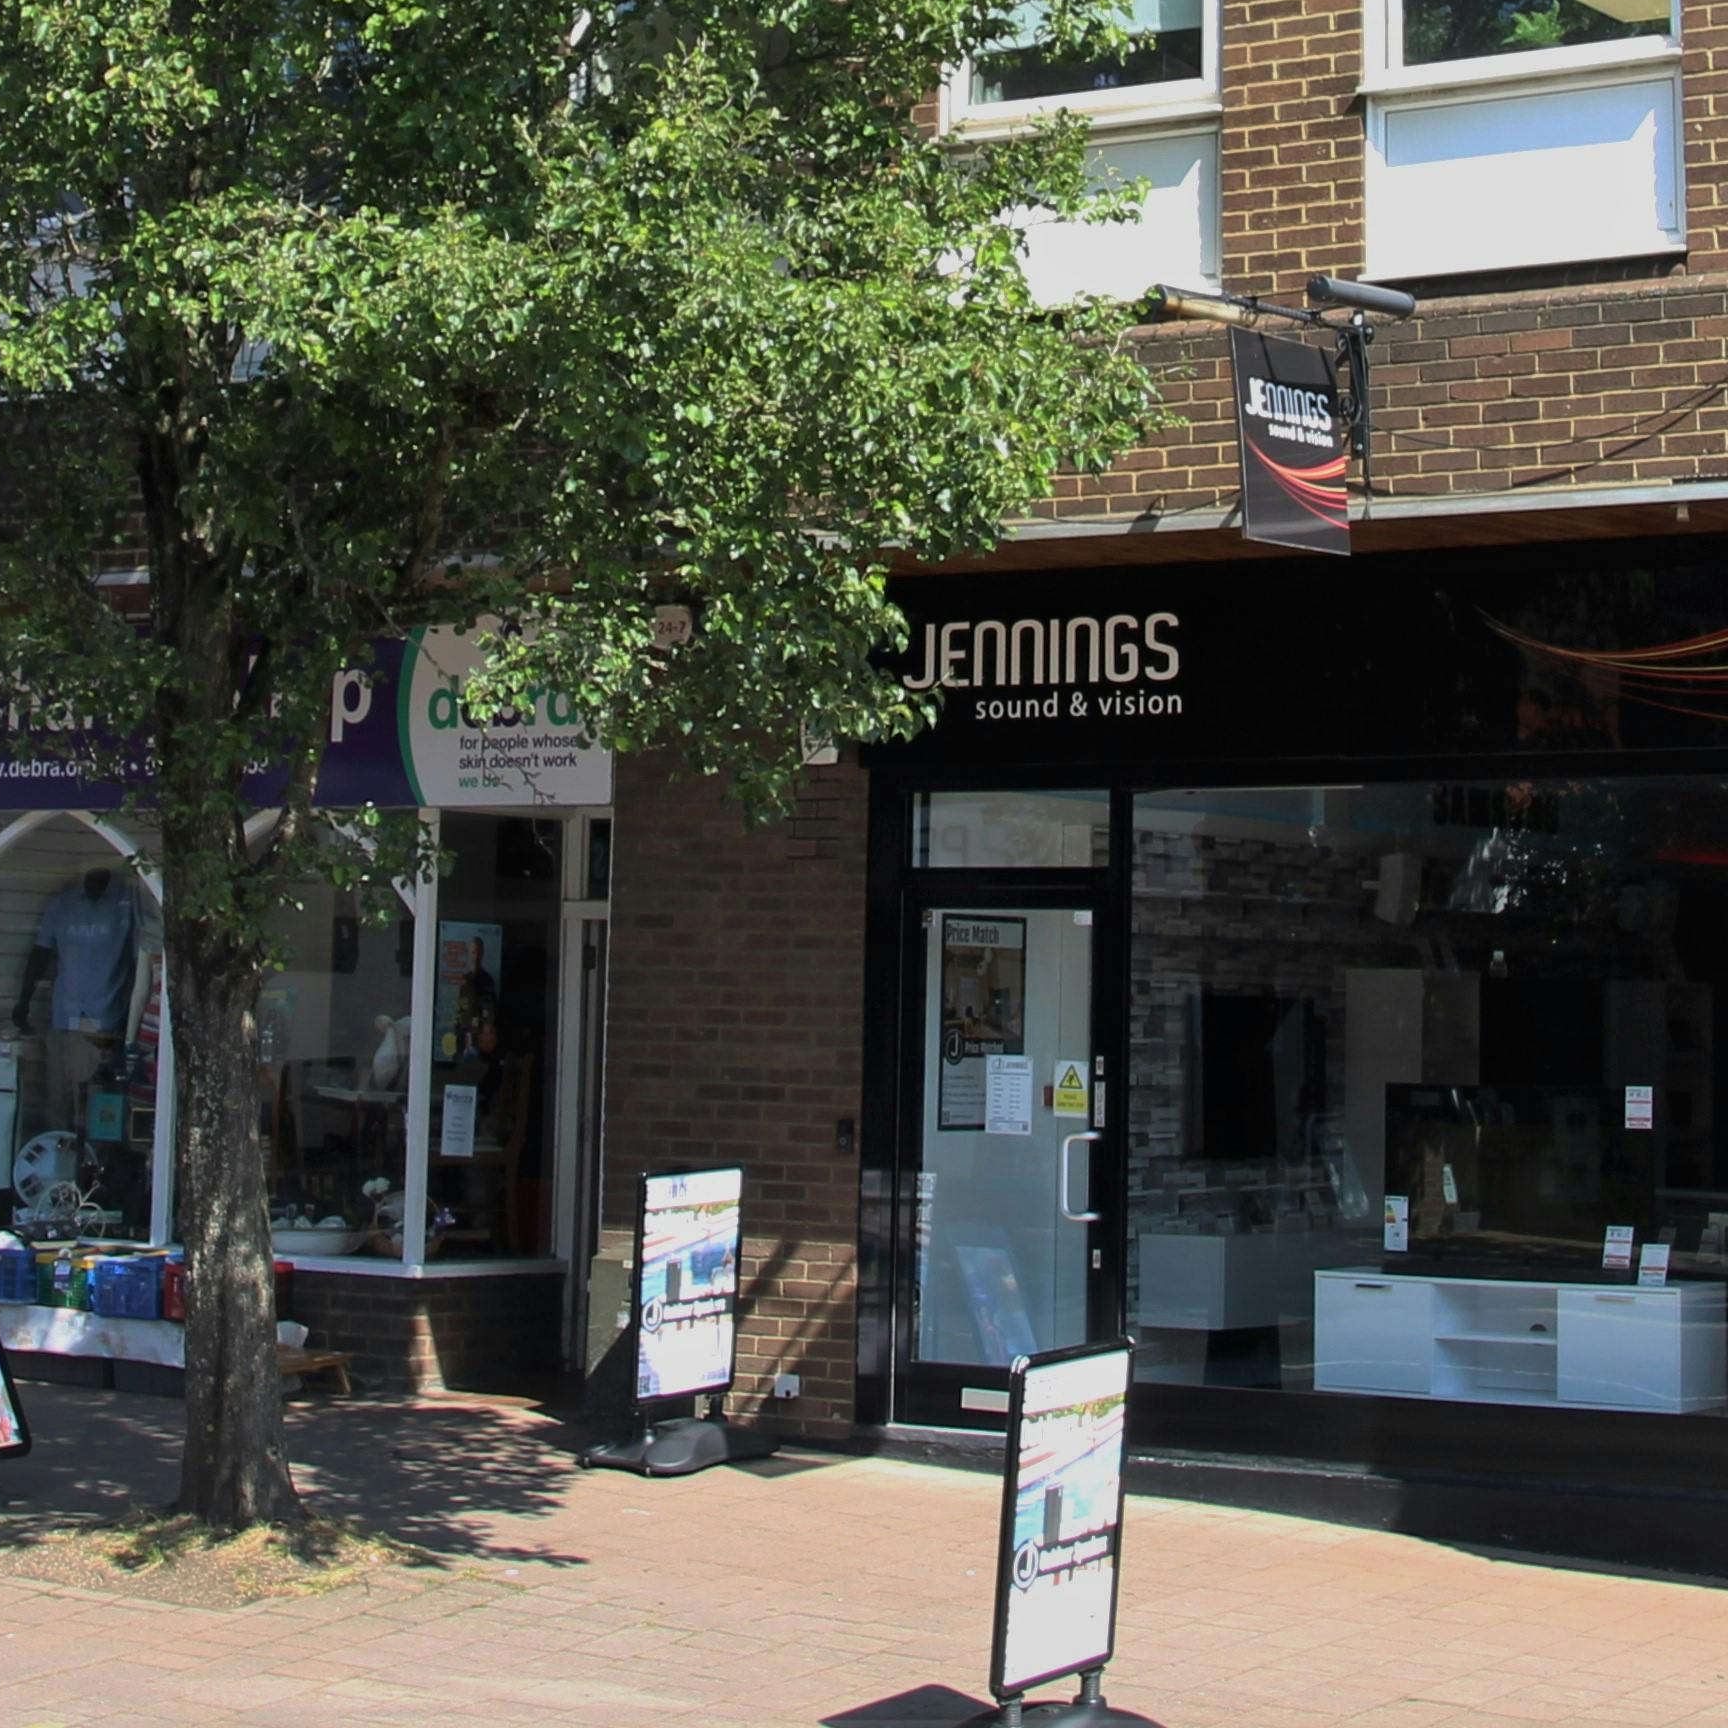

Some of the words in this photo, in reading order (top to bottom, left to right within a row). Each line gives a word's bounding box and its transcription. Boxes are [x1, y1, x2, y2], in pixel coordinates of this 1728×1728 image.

[1245, 377, 1332, 431] JENNINGS
[1268, 423, 1296, 441] sound
[1297, 427, 1305, 443] &
[1306, 429, 1334, 448] vision
[657, 621, 687, 635] 24-7
[903, 612, 1180, 689] JENNINGS
[975, 691, 1058, 720] sound
[1069, 691, 1088, 717] &
[1098, 690, 1183, 716] vision
[459, 735, 478, 750] for
[481, 736, 529, 754] people
[458, 754, 485, 770] skin
[489, 753, 540, 769] doesn't
[543, 753, 577, 769] work
[458, 776, 478, 788] we
[945, 922, 971, 944] Price
[972, 924, 1000, 946] Match
